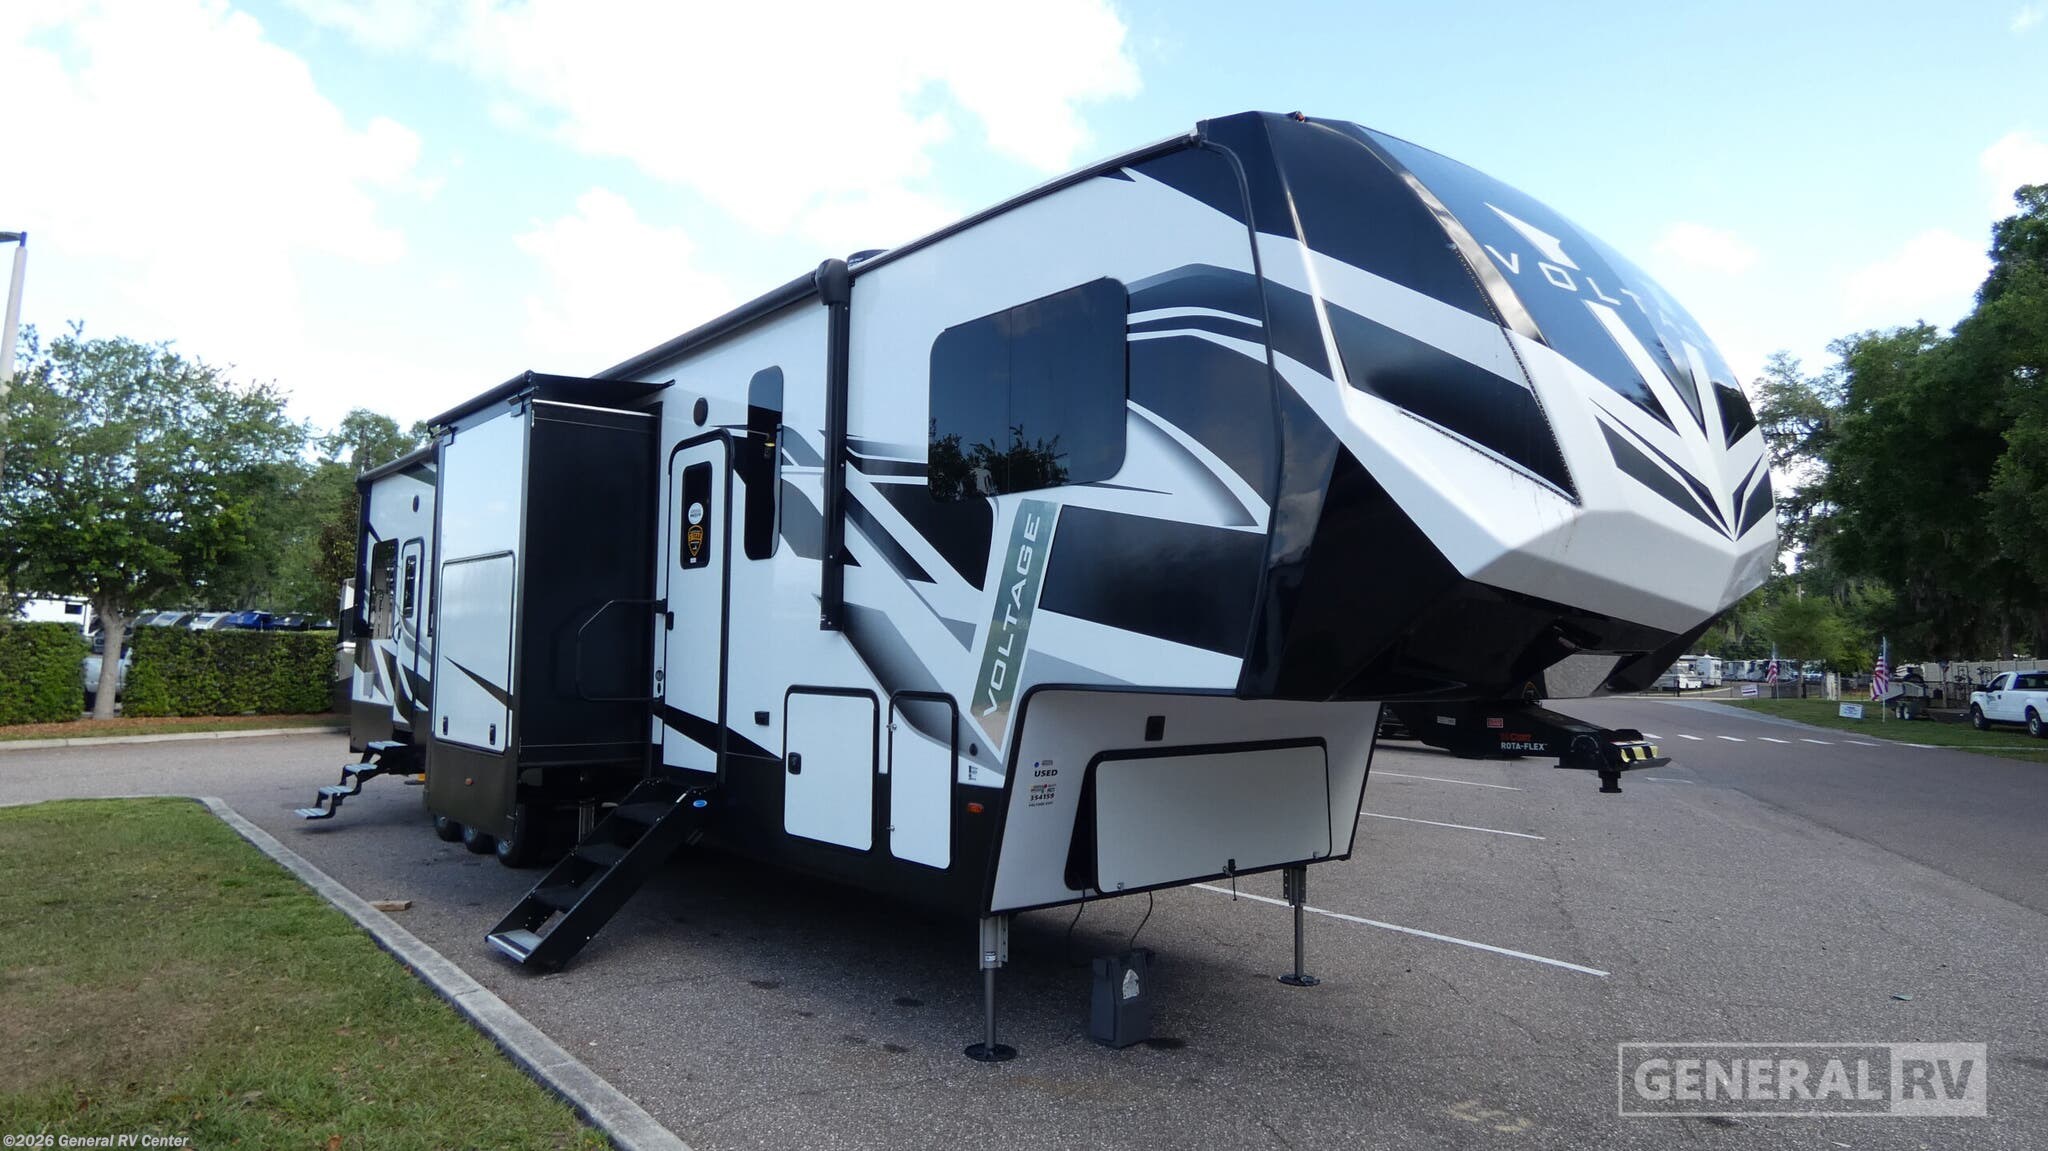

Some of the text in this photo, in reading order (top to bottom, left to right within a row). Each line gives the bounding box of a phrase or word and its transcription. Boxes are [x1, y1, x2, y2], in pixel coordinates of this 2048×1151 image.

[983, 513, 1040, 717] VOLTAGE
[1501, 741, 1545, 751] ROTA-FLEX
[1034, 769, 1058, 778] USED
